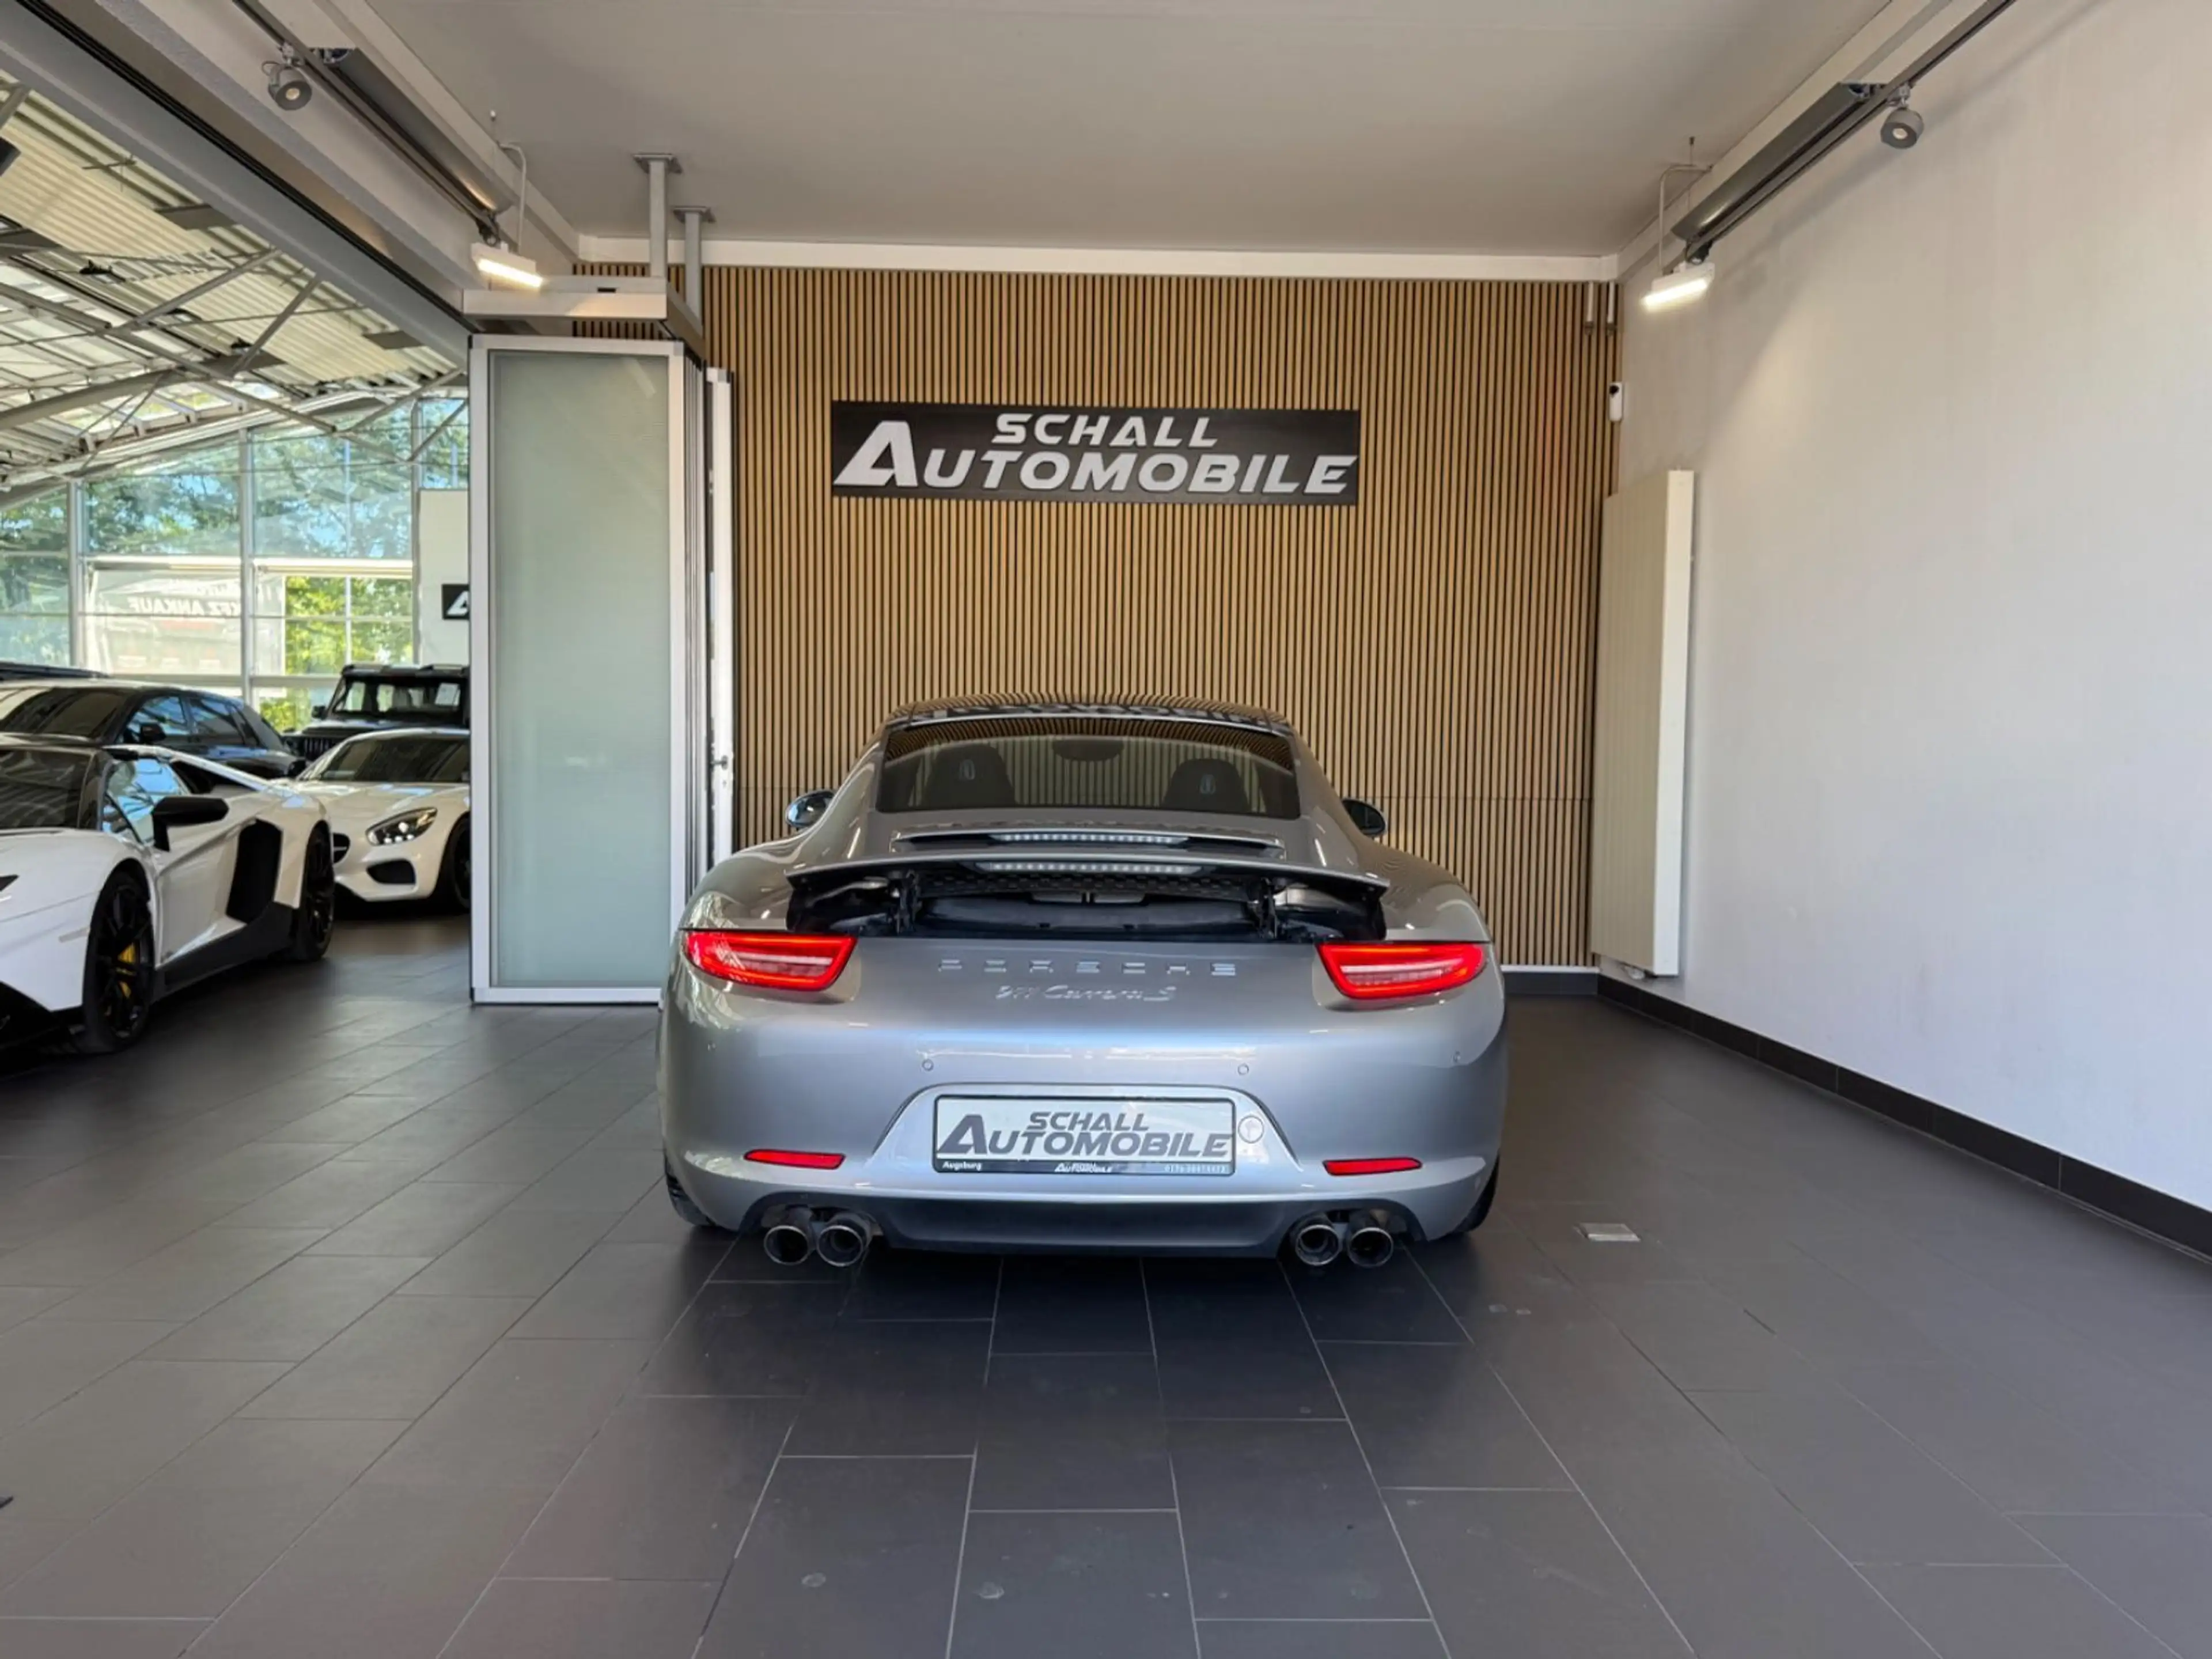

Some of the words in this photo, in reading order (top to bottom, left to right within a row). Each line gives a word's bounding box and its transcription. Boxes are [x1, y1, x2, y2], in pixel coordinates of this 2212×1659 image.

[992, 412, 1218, 448] SCHALL
[833, 420, 1358, 494] AUTOMOBILE
[937, 959, 1236, 976] PORSCHE
[937, 1113, 1233, 1158] AUTOMOBILE
[1026, 1111, 1150, 1132] SCHALL
[942, 1161, 982, 1172] Augsburg
